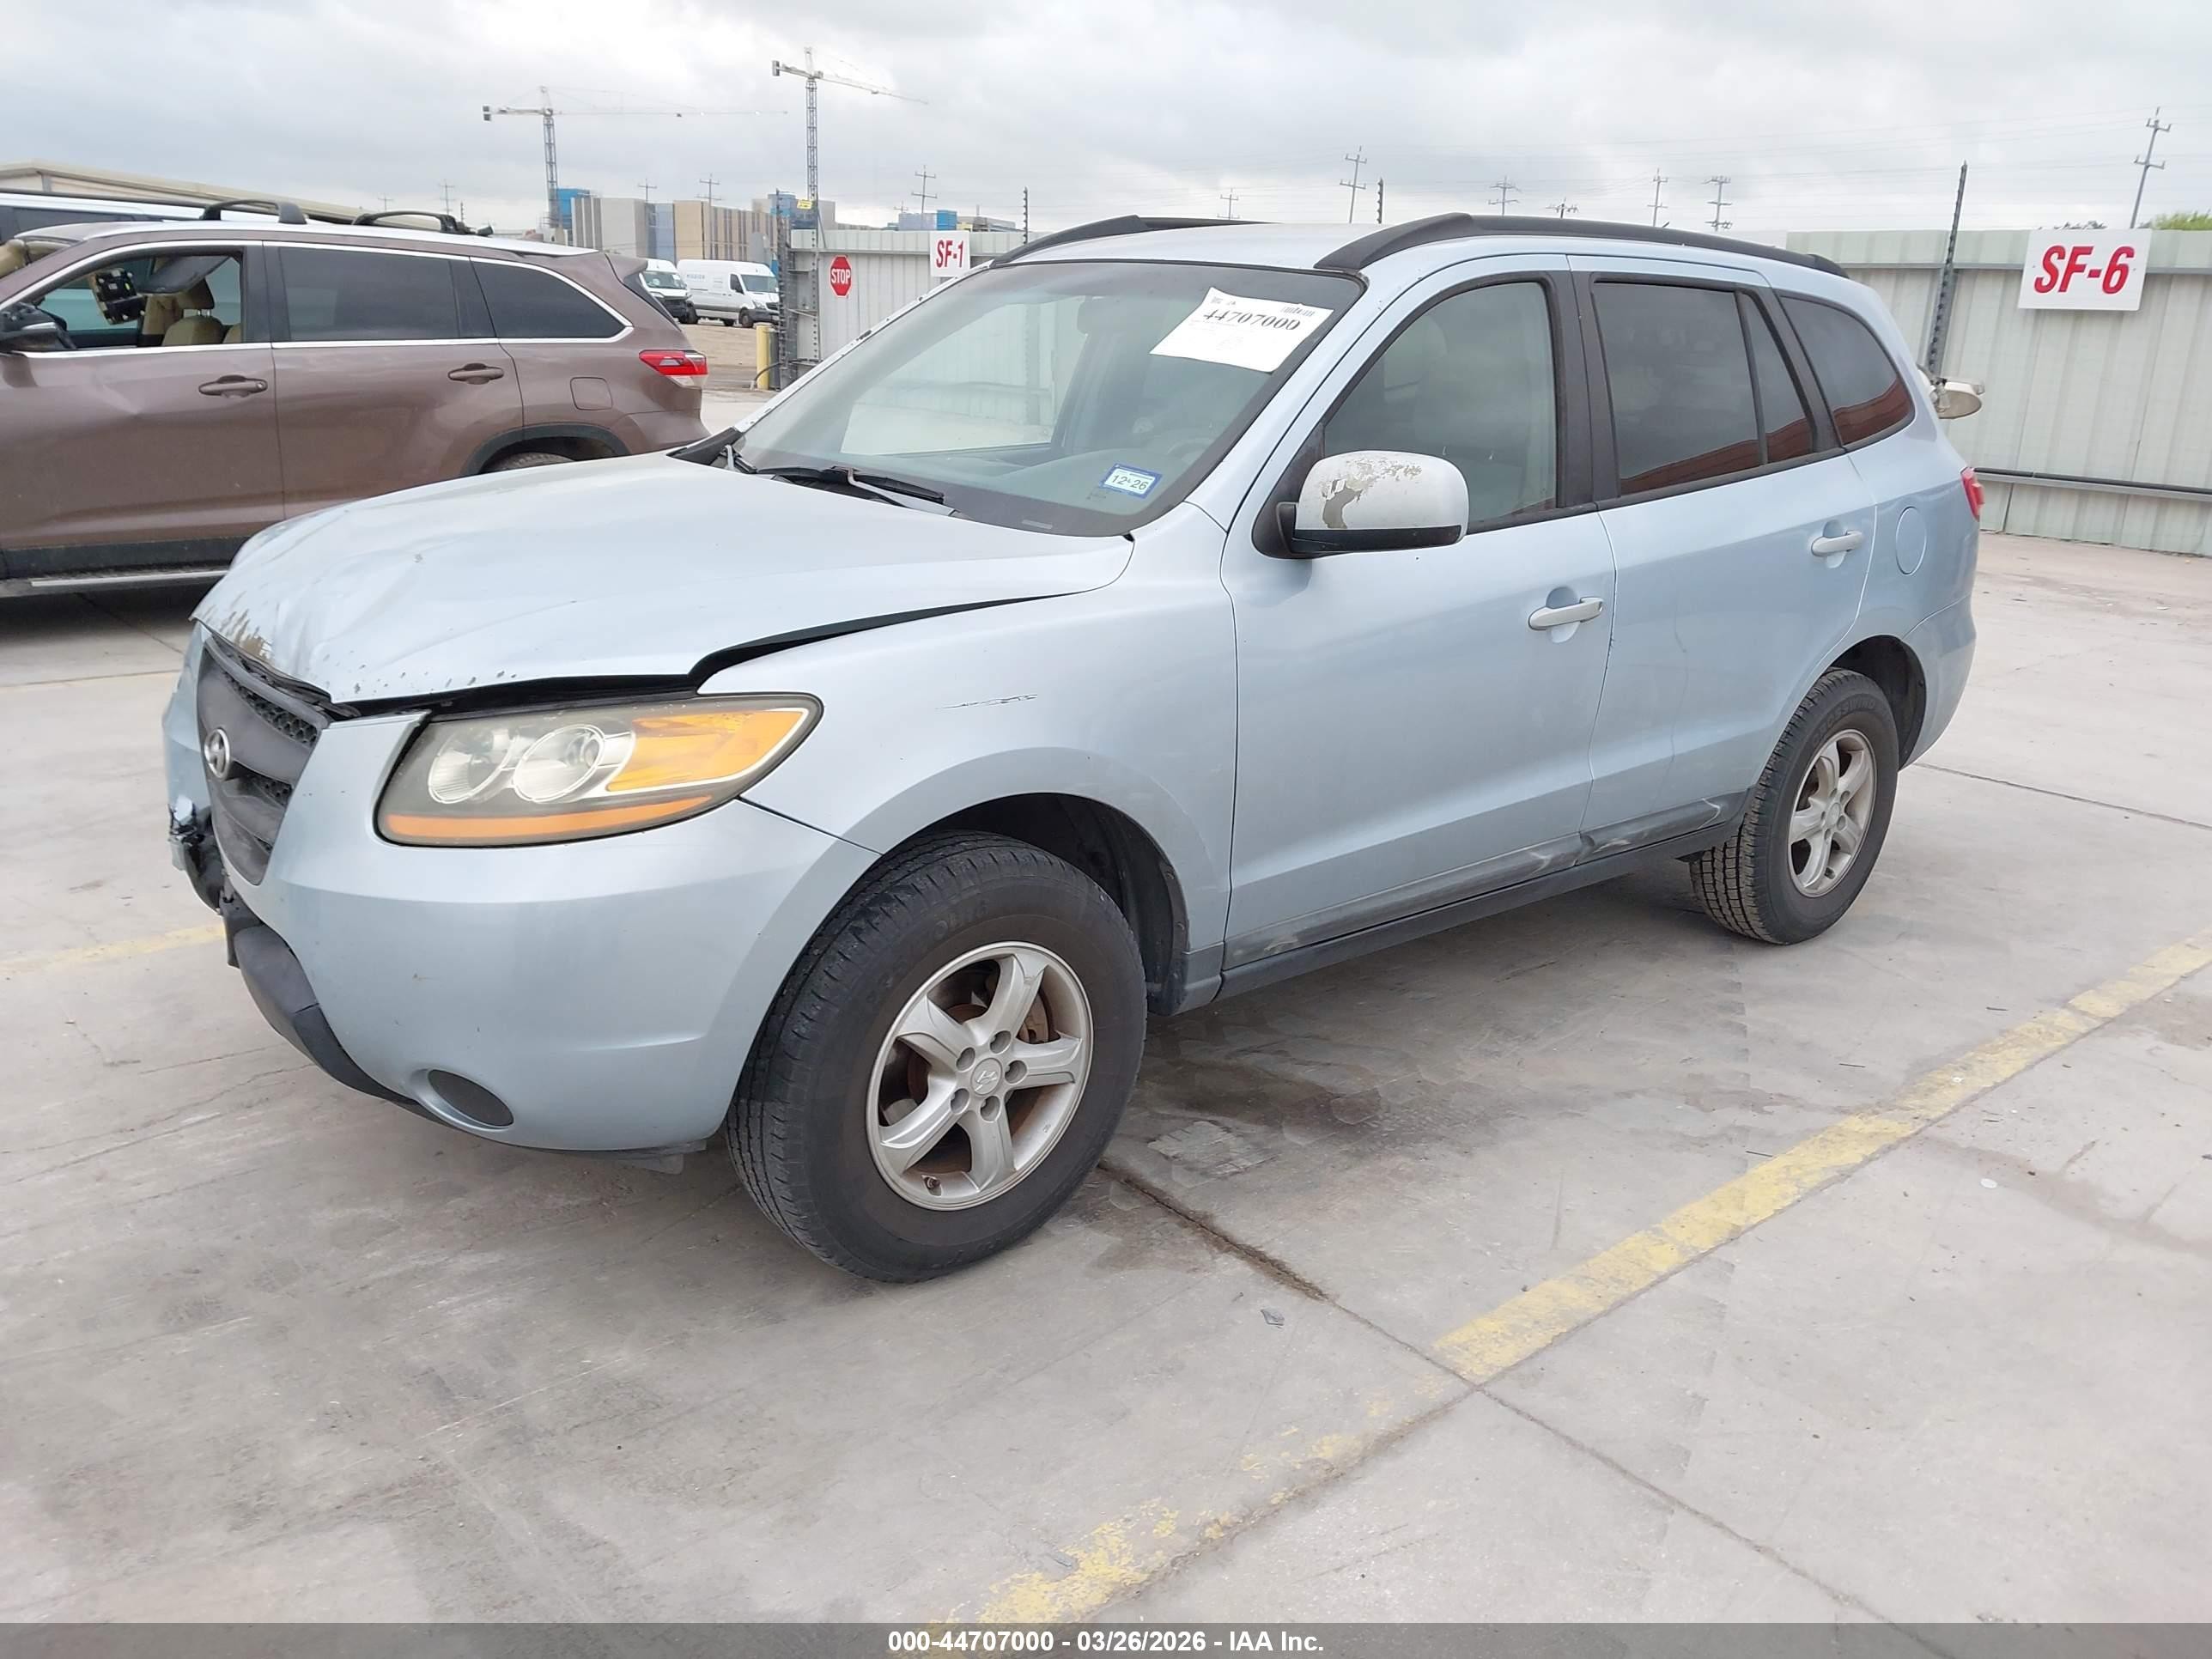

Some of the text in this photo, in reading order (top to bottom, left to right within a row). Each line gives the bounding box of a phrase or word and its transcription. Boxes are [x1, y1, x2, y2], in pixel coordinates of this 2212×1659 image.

[936, 240, 964, 268] SF-1
[830, 269, 851, 284] STOP
[2033, 244, 2136, 295] SF-6
[1203, 309, 1301, 331] 44707000
